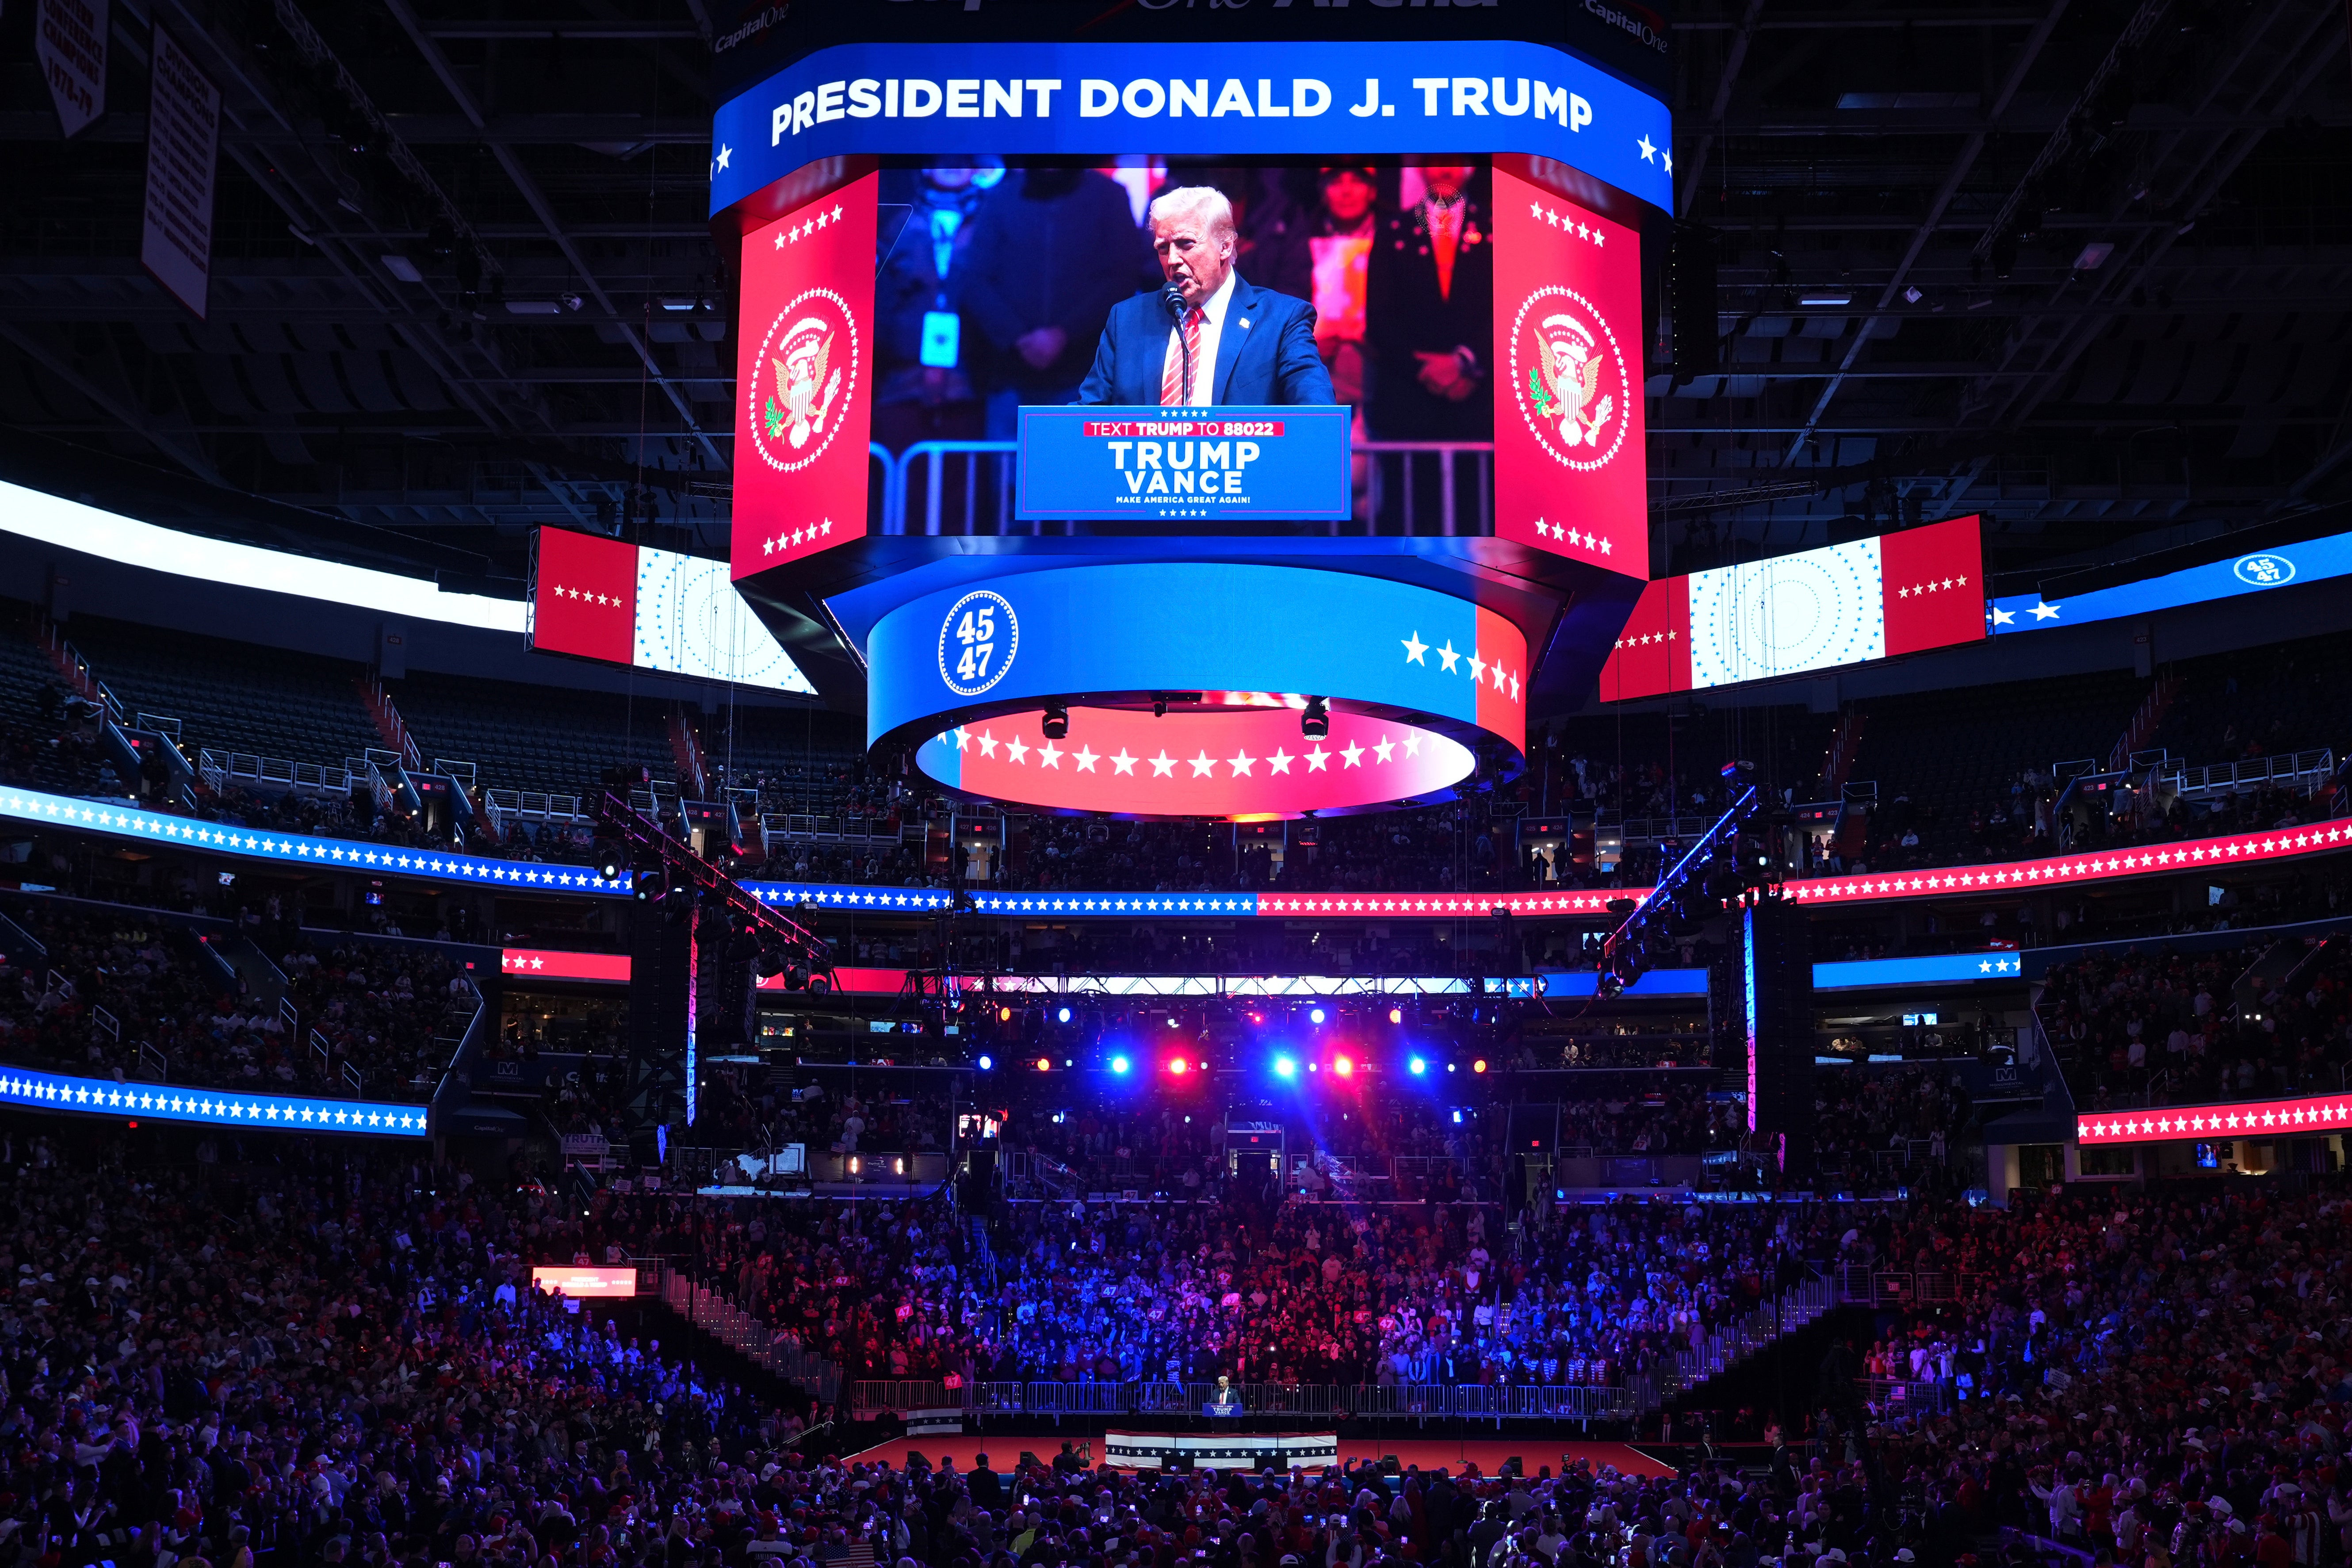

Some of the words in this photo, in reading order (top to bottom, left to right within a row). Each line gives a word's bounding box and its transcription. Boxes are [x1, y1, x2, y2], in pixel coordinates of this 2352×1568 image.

[44, 19, 99, 85] CHAMPIONS
[165, 43, 208, 98] DIVISION
[48, 56, 92, 117] 1978-79
[157, 56, 215, 129] CHAMPIONS
[772, 80, 1061, 146] PRESIDENT
[1080, 79, 1331, 118] DONALD
[1350, 78, 1394, 117] J.
[1413, 77, 1592, 132] TRUMP
[1091, 422, 1132, 436] TEXT
[1136, 422, 1193, 436] TRUMP
[1197, 422, 1219, 436] TO
[1224, 422, 1274, 436] 88022
[1108, 442, 1259, 469] TRUMP
[1125, 471, 1241, 493] VANCE
[2247, 558, 2275, 572] 45
[2257, 568, 2280, 581] 47
[957, 606, 994, 645] 45
[957, 642, 994, 680] 47
[566, 1134, 605, 1143] TRUTH
[1356, 1222, 1366, 1232] 47
[1091, 1239, 1098, 1252] 47
[1698, 1245, 1708, 1254] 47
[759, 1257, 771, 1265] 47
[1219, 1273, 1231, 1284] 47
[1103, 1287, 1116, 1296] 47
[898, 1305, 910, 1316] 47
[1149, 1310, 1163, 1319] 47
[1380, 1319, 1393, 1328] 47
[946, 1377, 959, 1387] 47
